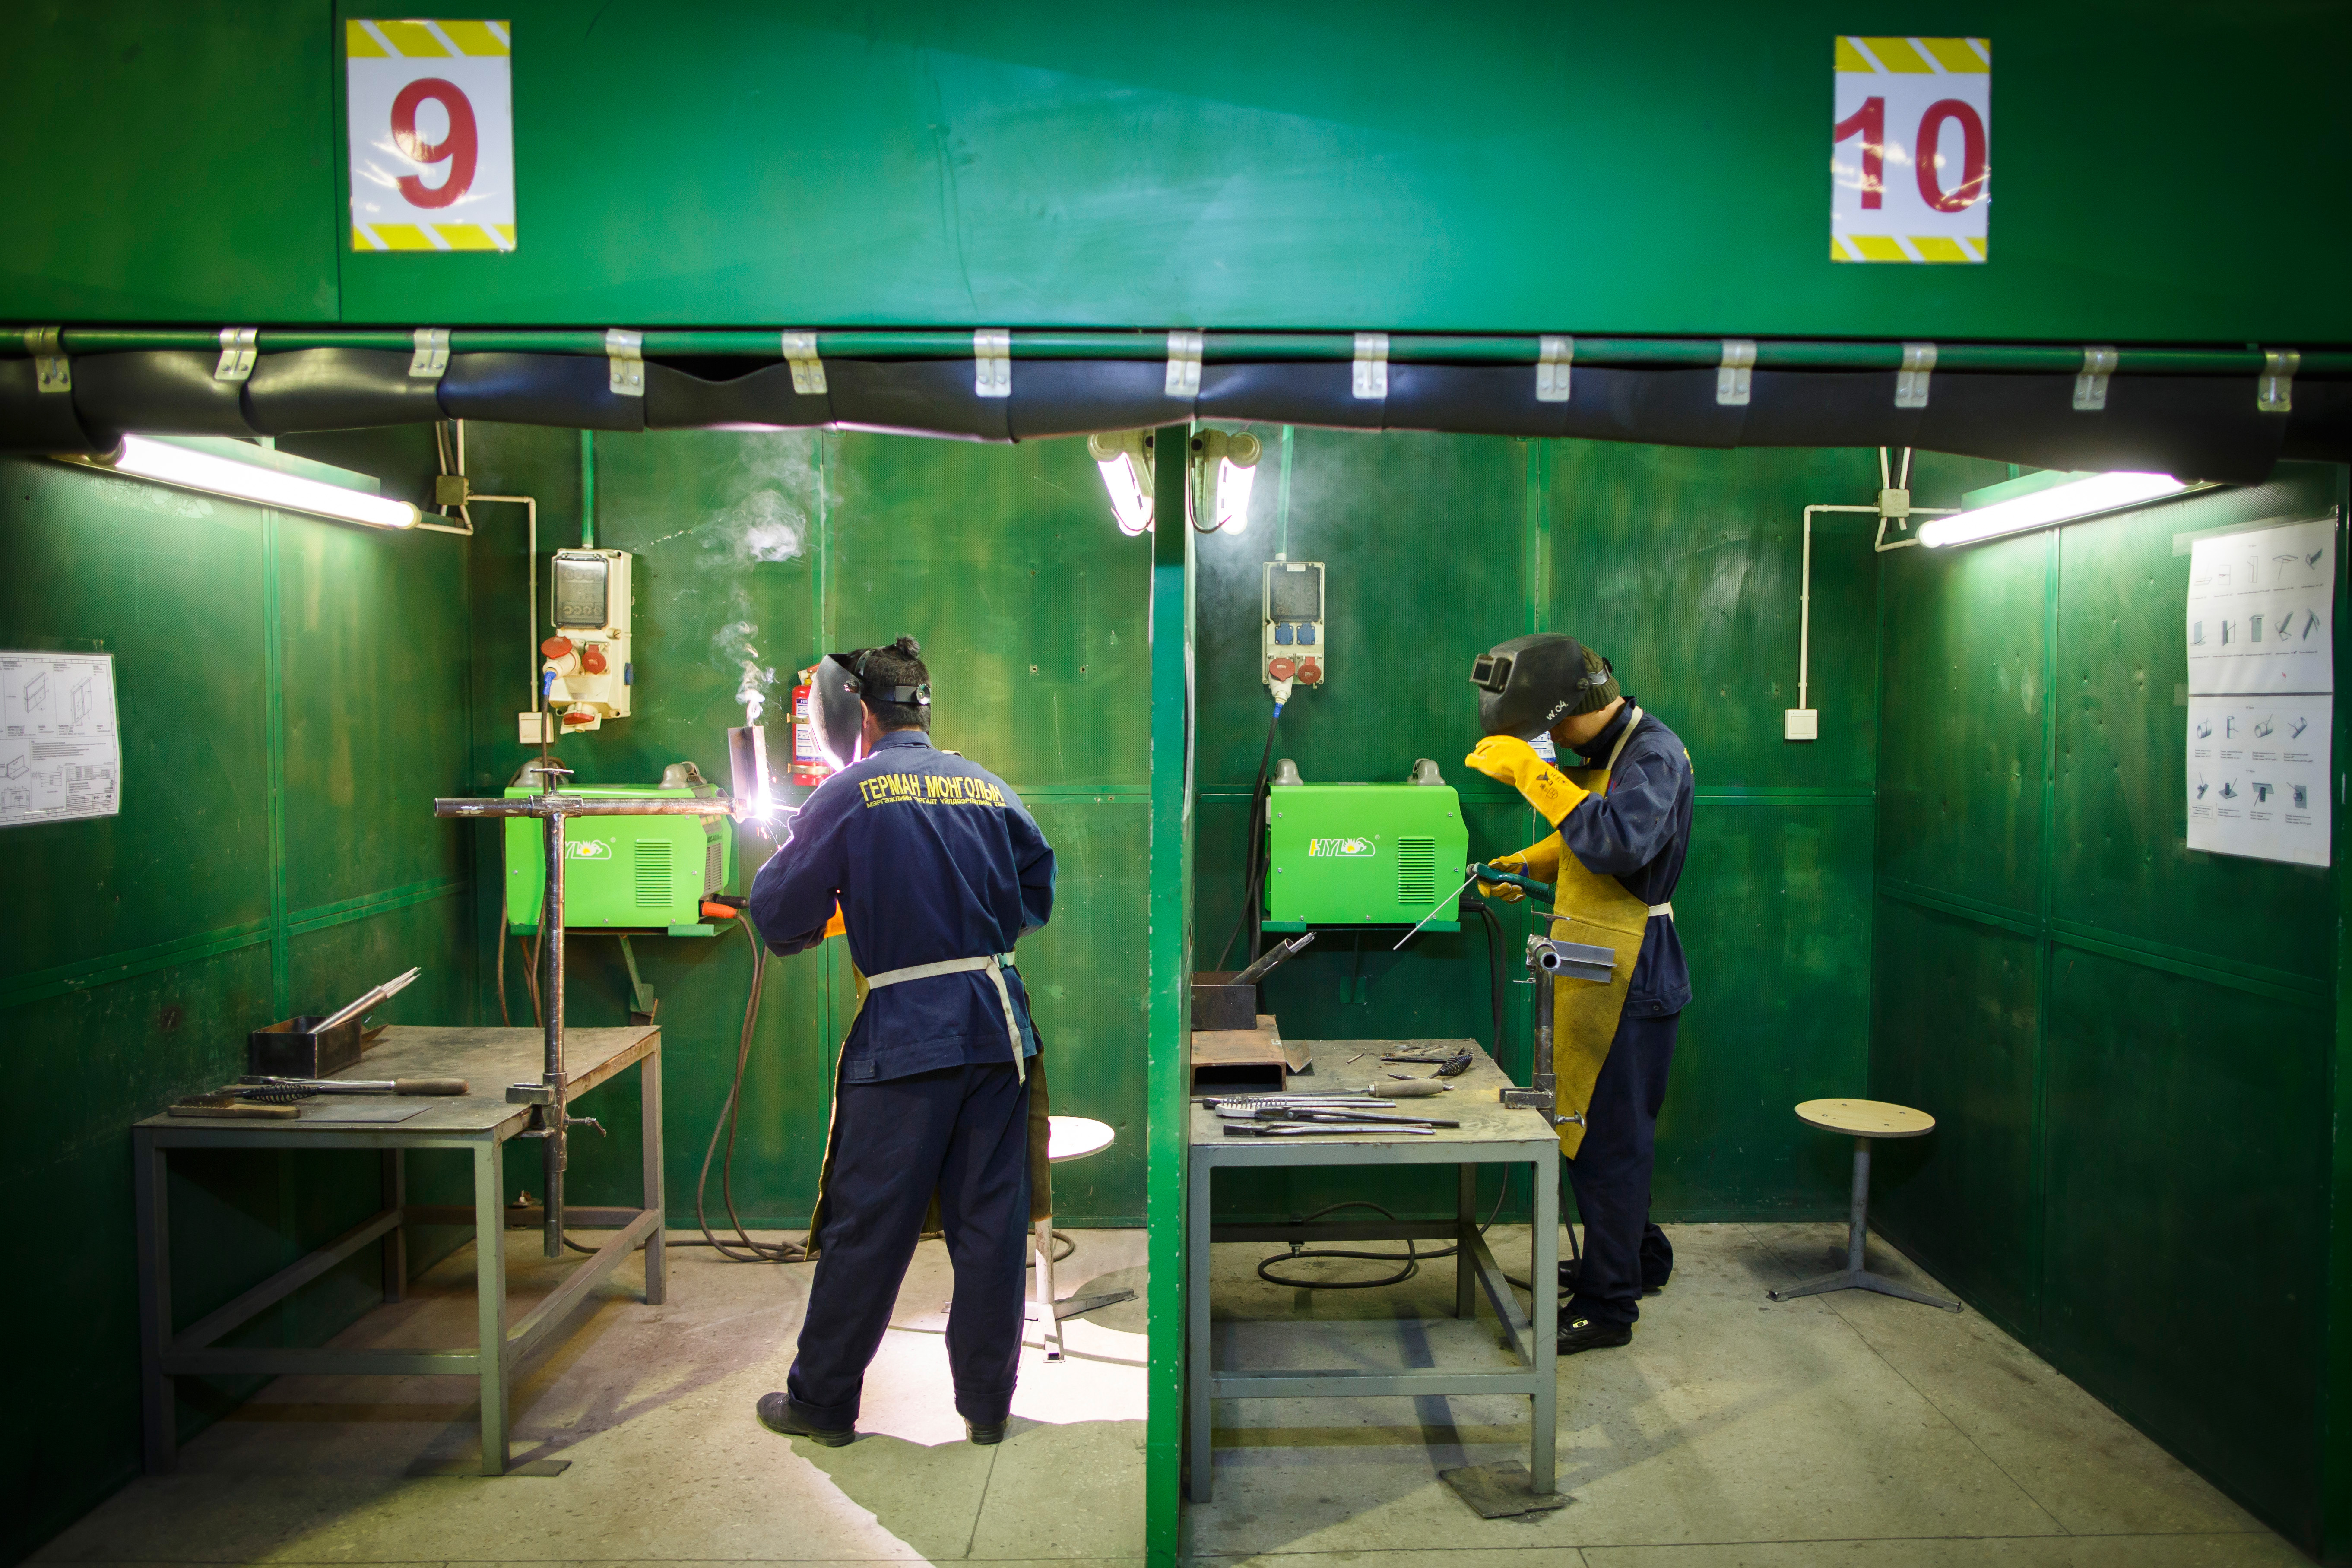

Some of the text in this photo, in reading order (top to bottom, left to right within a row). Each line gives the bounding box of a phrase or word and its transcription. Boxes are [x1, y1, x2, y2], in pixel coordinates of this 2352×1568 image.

[391, 77, 478, 209] 9
[1835, 96, 1986, 213] 10
[859, 773, 1005, 802] ГЕРМАН МОНГОЛЫН
